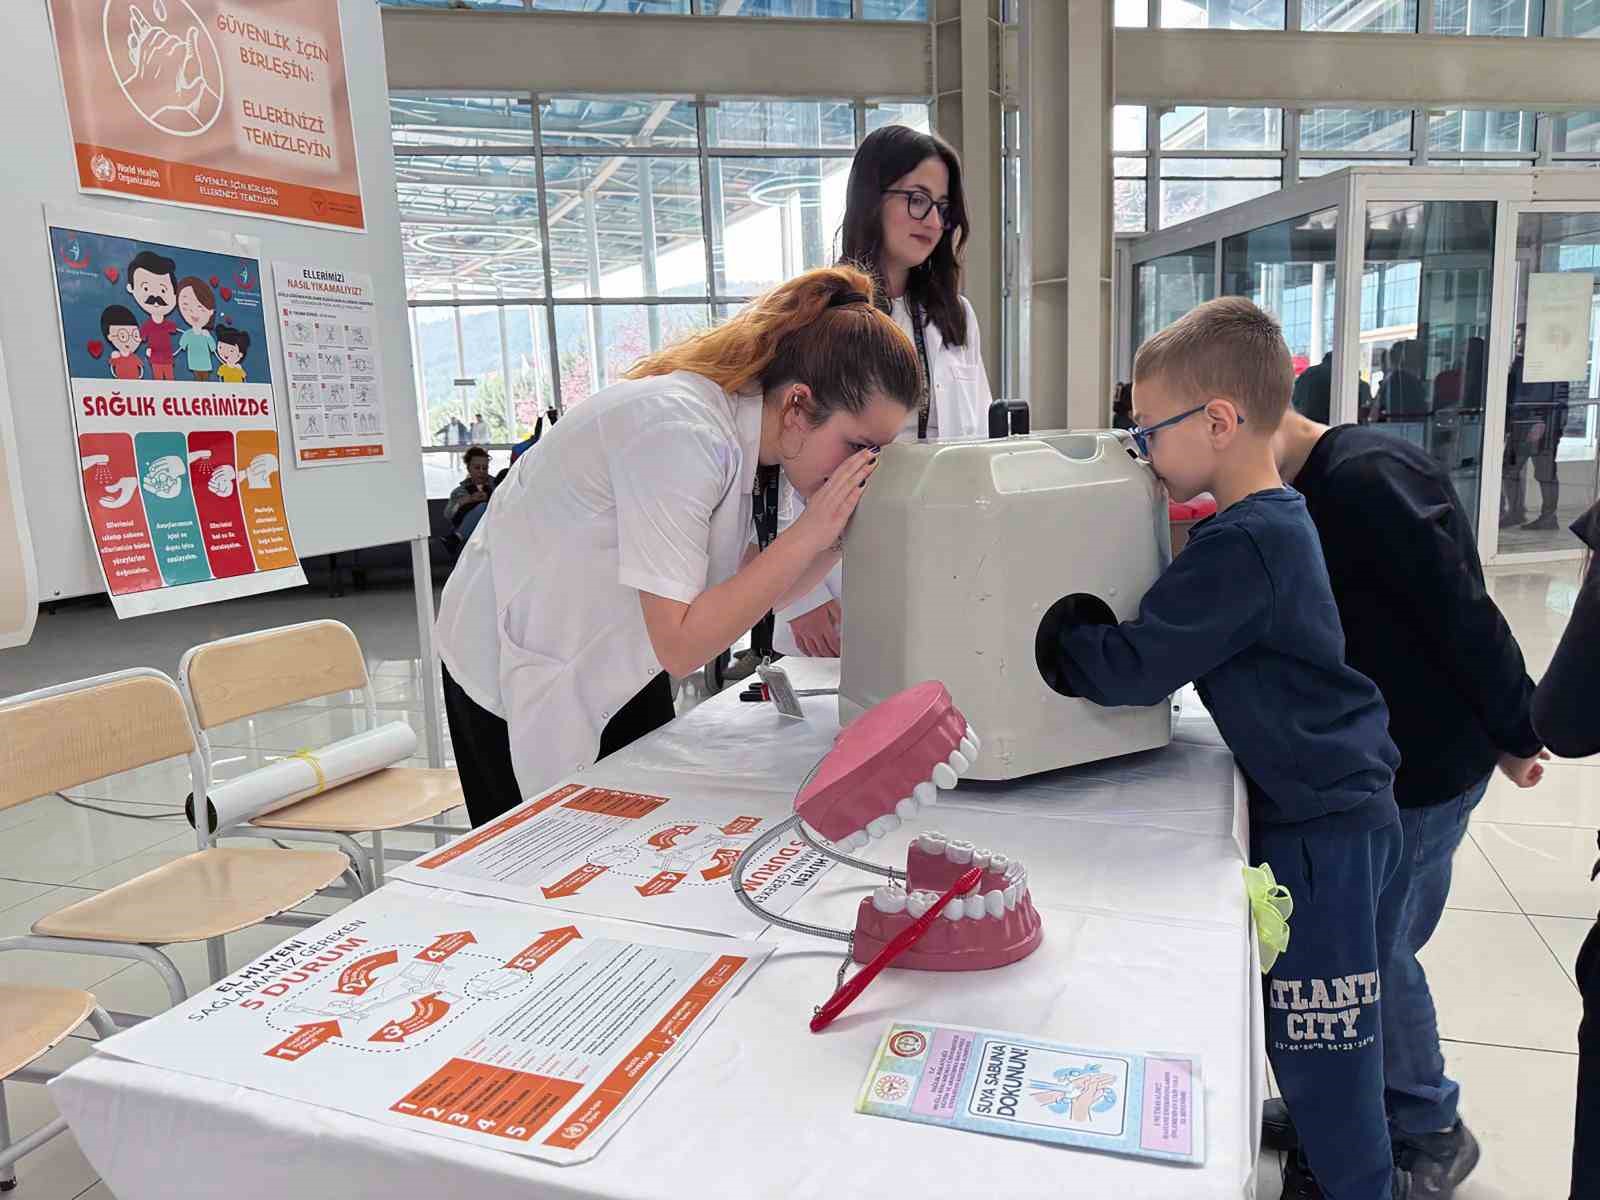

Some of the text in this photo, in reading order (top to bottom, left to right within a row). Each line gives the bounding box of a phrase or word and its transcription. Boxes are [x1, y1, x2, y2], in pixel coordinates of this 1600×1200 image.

[217, 14, 329, 63] GÜVENLİK İÇİN
[240, 46, 315, 82] BİRLEŞİN:
[243, 98, 325, 134] ELLERİNİZİ
[242, 125, 331, 159] TEMİZLEYİN
[137, 166, 159, 178] Health
[303, 268, 345, 283] ELLERİMİZİ
[287, 278, 310, 291] NASIL
[83, 391, 270, 417] SAĞLIK ELLERİMİZDE
[742, 847, 802, 892] DURUM
[299, 919, 367, 959] GEREKEN
[427, 950, 447, 959] 4
[512, 957, 537, 969] 5
[239, 937, 369, 1010] 5 DURUM
[216, 981, 243, 994] EL
[342, 979, 368, 992] 2
[1286, 1007, 1361, 1040] CITY
[381, 1026, 405, 1040] 3
[276, 1047, 300, 1057] 1
[977, 1045, 1007, 1114] SUYA SABUNA
[997, 1047, 1029, 1117] DOKUNUN!
[398, 1102, 417, 1111] 1
[422, 1107, 446, 1118] 2
[448, 1112, 470, 1125] 3
[475, 1118, 497, 1130] 4
[505, 1126, 527, 1138] 5
